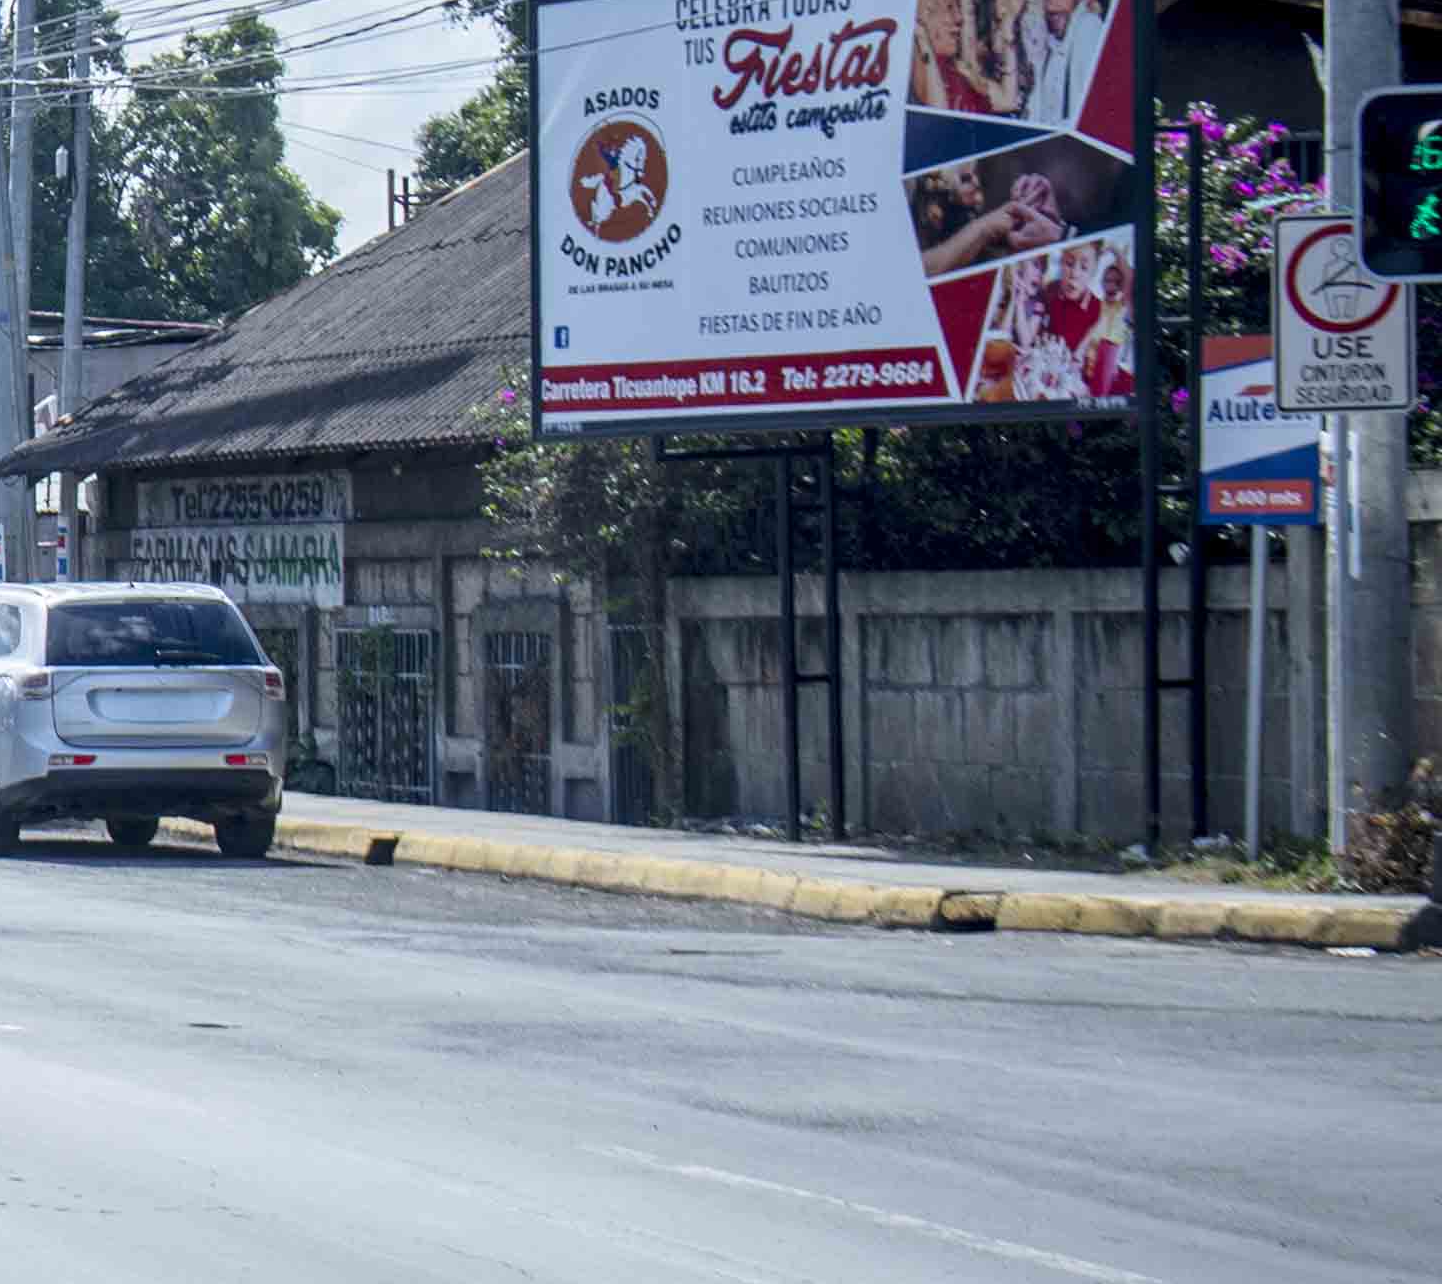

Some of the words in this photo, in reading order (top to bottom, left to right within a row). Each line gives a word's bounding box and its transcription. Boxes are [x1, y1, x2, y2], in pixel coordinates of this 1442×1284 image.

[684, 37, 715, 66] TUS
[713, 18, 898, 109] Fiestas
[584, 87, 660, 117] ASADOS
[730, 101, 777, 135] estilo
[786, 89, 890, 139] campestre
[732, 156, 847, 187] CUMPLEAÑOS
[703, 200, 795, 227] REUNIONES
[799, 192, 878, 218] SOCIALES
[560, 233, 600, 275] DON
[605, 222, 682, 278] PANCHO
[735, 231, 850, 259] COMUNIONES
[749, 270, 829, 295] BAUTIZOS
[699, 313, 760, 336] FIESTAS
[762, 313, 784, 332] DE
[786, 311, 814, 330] FIN
[817, 309, 840, 328] DE
[842, 302, 883, 326] AÑO
[1312, 335, 1373, 360] USE
[541, 377, 611, 404] Carretera
[612, 374, 698, 402] Ticuantepe
[699, 371, 726, 394] KM
[729, 369, 767, 394] 16.2
[780, 366, 819, 390] Tel:
[821, 360, 934, 389] 2279-9684
[1298, 362, 1386, 383] CINTURON
[1293, 383, 1394, 405] SEGURIDAD
